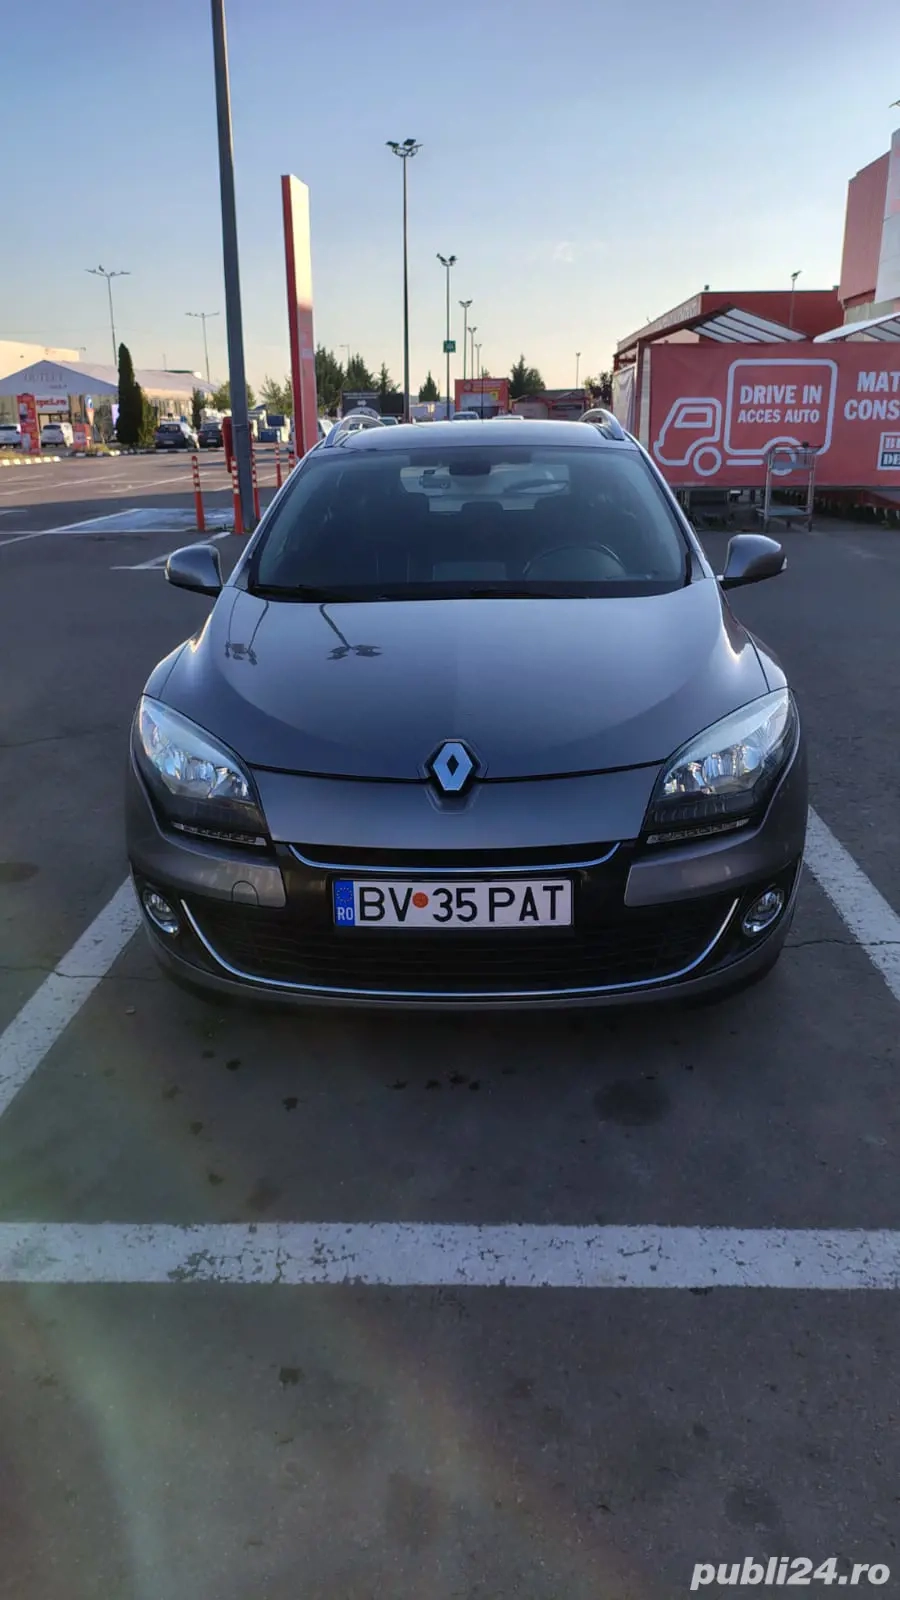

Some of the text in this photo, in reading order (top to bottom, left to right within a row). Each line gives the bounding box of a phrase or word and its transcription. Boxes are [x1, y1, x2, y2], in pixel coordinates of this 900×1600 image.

[857, 371, 900, 392] MAT
[739, 384, 823, 405] DRIVE IN
[737, 409, 821, 424] ACCES AUTO
[844, 398, 900, 420] CONS
[336, 906, 354, 921] RO
[359, 885, 564, 923] BV 35 PAT
